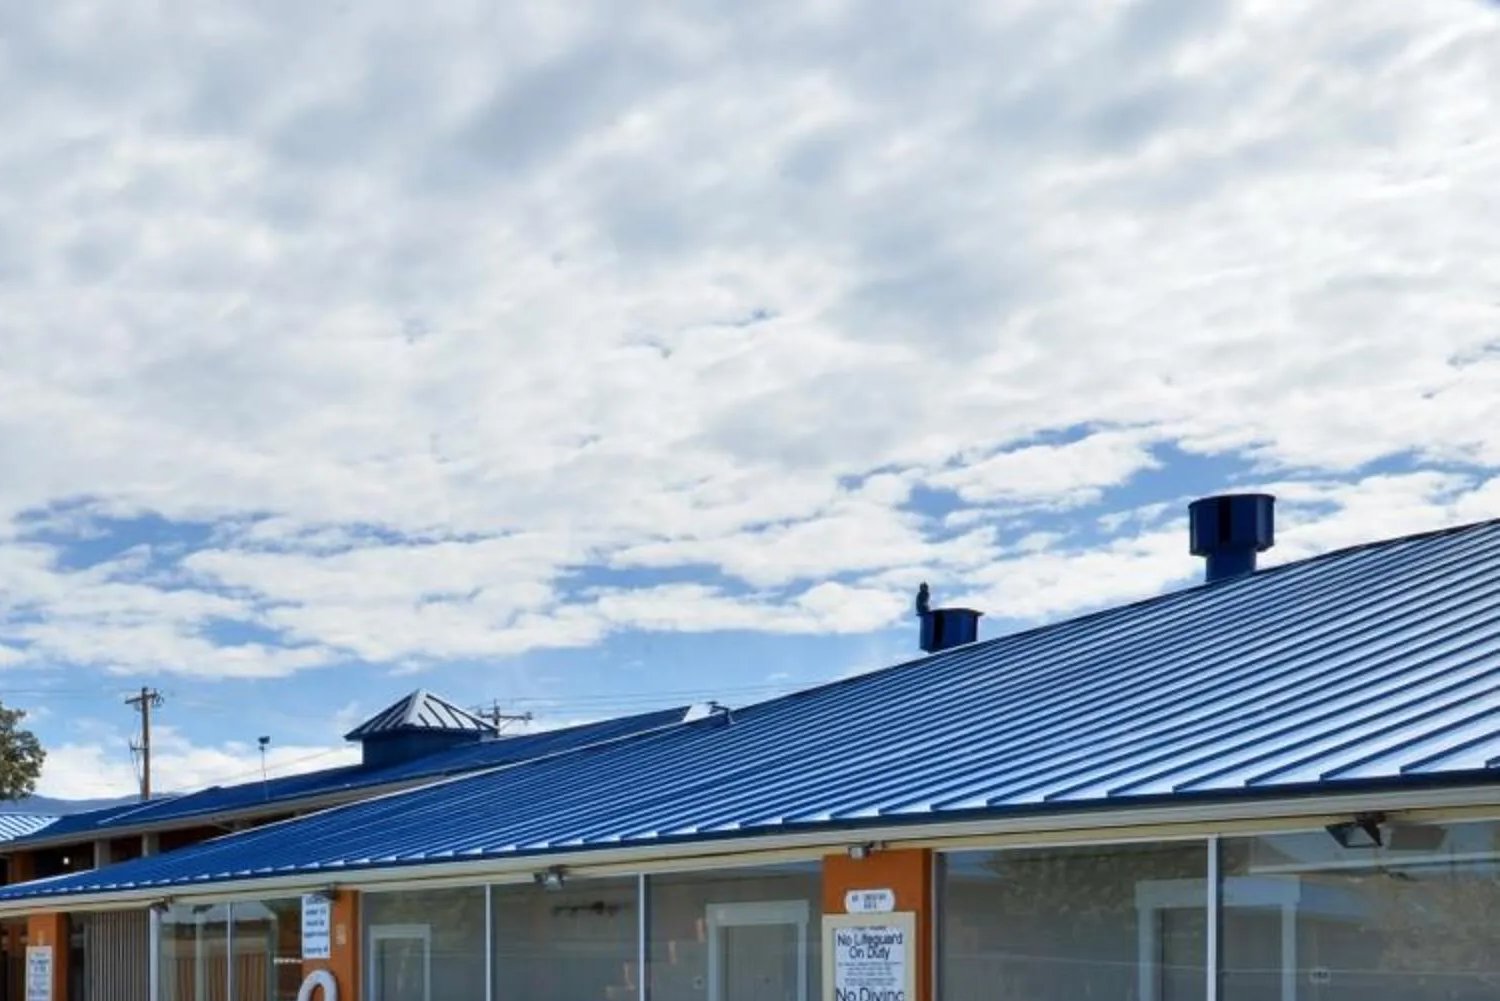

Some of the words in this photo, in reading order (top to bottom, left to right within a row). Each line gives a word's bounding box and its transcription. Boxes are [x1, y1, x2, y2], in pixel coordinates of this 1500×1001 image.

[837, 933, 852, 946] No
[854, 931, 903, 950] Lifeguard
[849, 946, 864, 959] On
[867, 946, 891, 961] Duty
